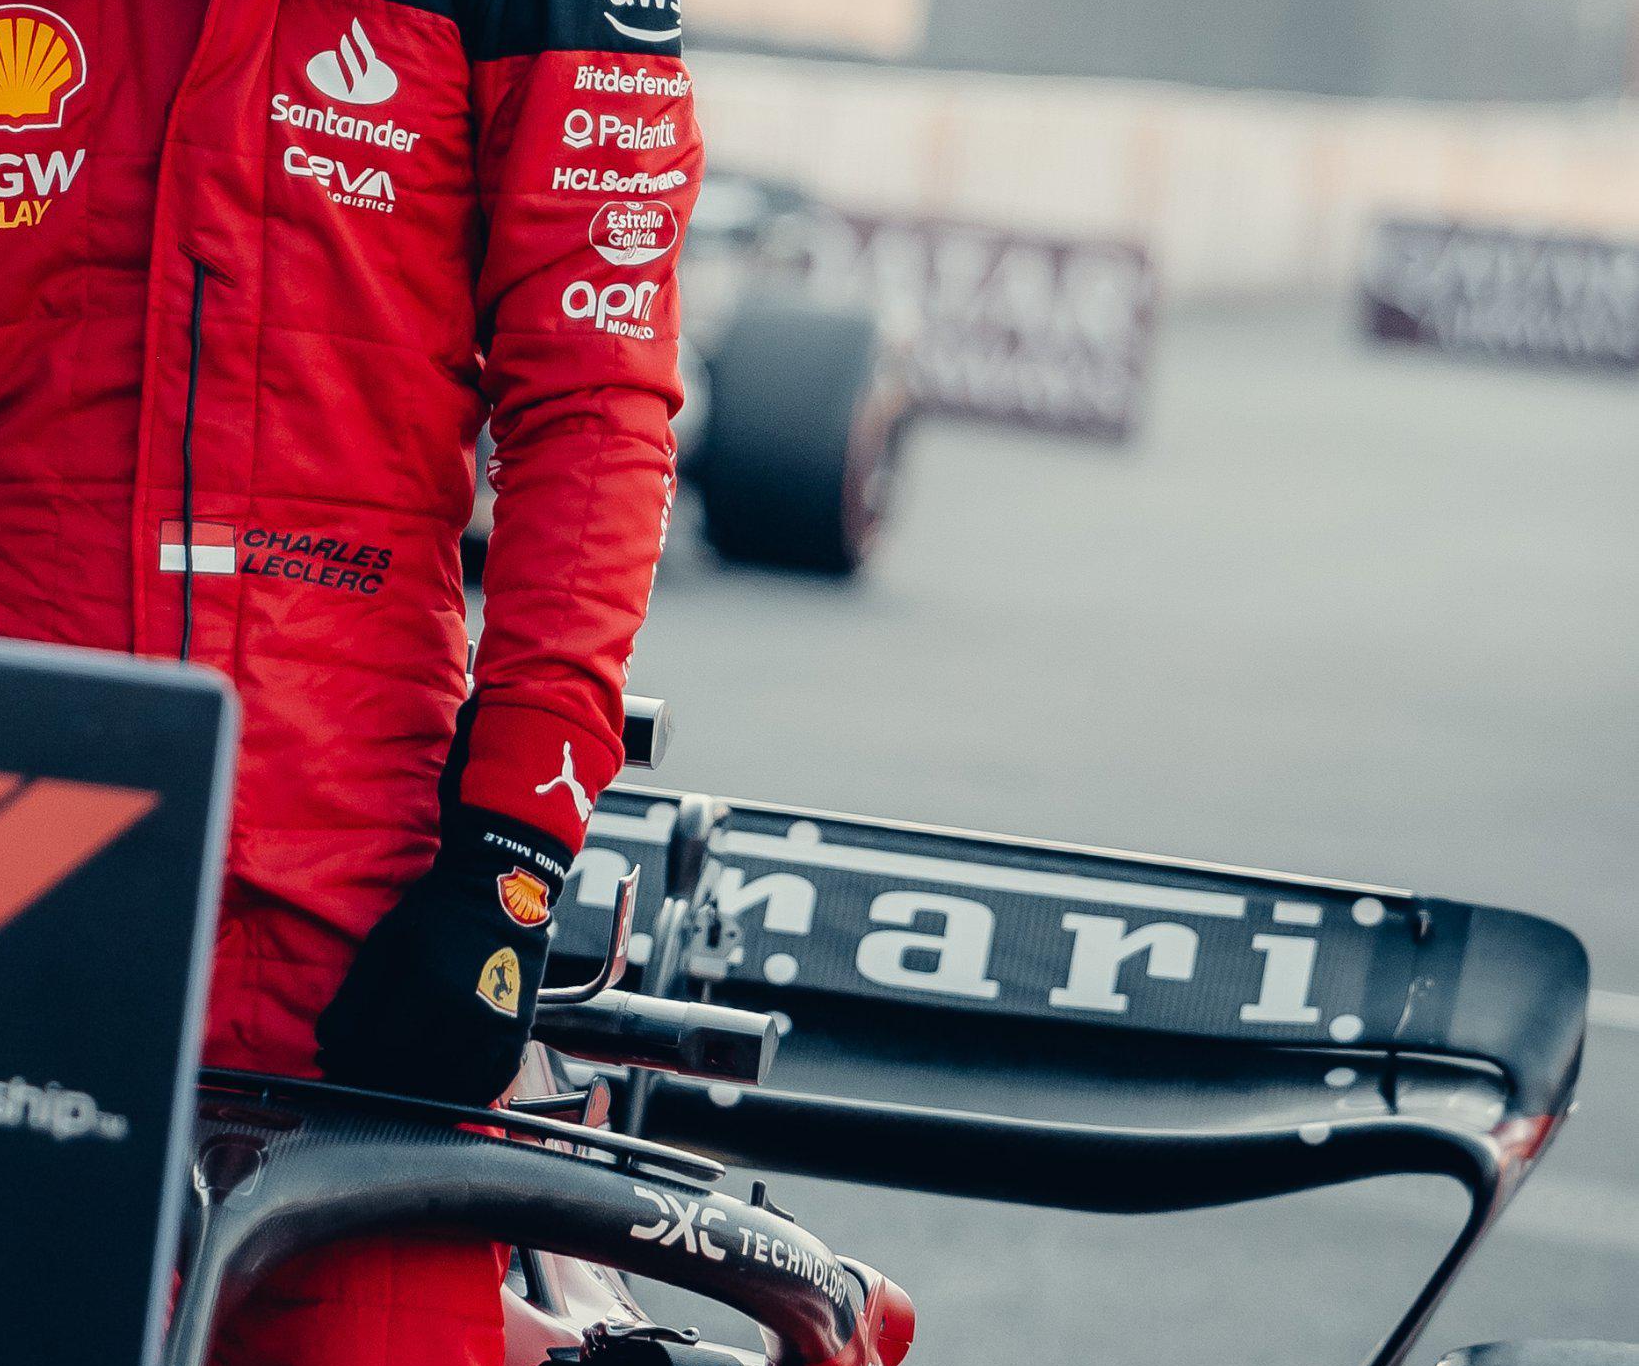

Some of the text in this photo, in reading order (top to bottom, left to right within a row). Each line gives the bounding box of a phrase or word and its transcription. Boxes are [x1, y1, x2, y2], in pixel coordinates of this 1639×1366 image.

[574, 65, 692, 97] Bitdefender
[271, 93, 421, 153] Santander
[599, 115, 677, 151] Palantir
[607, 211, 664, 230] Estrella
[242, 528, 393, 571] CHARLES
[240, 552, 383, 595] LECLERC
[630, 1185, 849, 1308] DXC TECHNOLOGY
